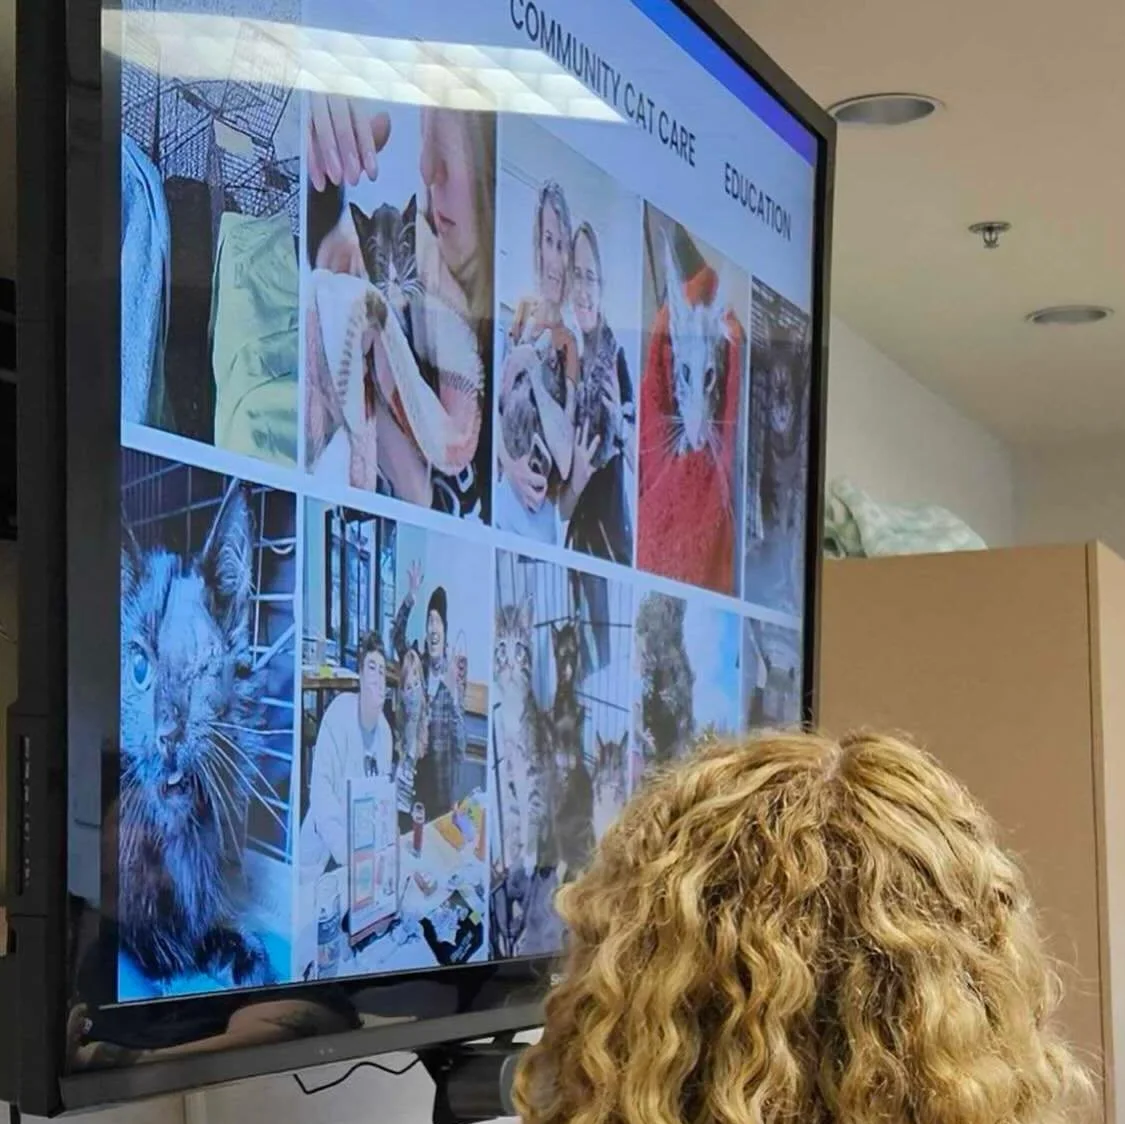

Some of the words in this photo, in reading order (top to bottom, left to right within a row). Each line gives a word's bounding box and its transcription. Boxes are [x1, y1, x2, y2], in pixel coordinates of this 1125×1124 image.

[510, 0, 621, 106] COMMUNITY
[623, 82, 656, 137] CAT
[659, 110, 697, 167] CARE
[724, 162, 792, 242] EDUCATION
